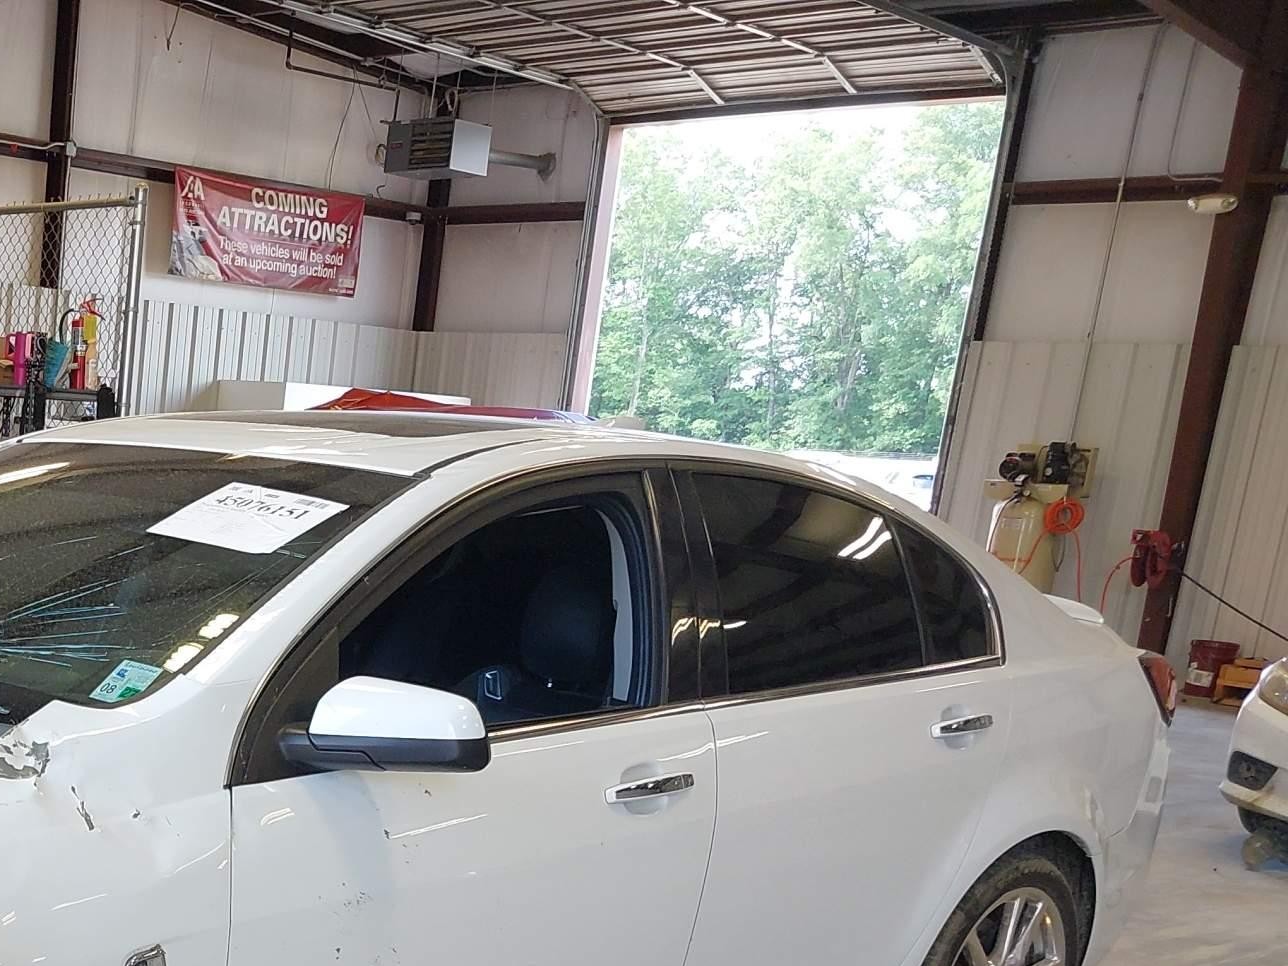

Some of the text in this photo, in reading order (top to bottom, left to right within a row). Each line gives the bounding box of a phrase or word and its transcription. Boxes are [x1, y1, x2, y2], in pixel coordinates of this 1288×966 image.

[251, 187, 329, 219] COMING
[216, 206, 354, 245] ATTRACTIONS!
[219, 236, 344, 266] These vehicles will be sold
[222, 252, 337, 280] at an upcoming auction!
[215, 494, 310, 520] 45076151
[99, 682, 118, 694] 08
